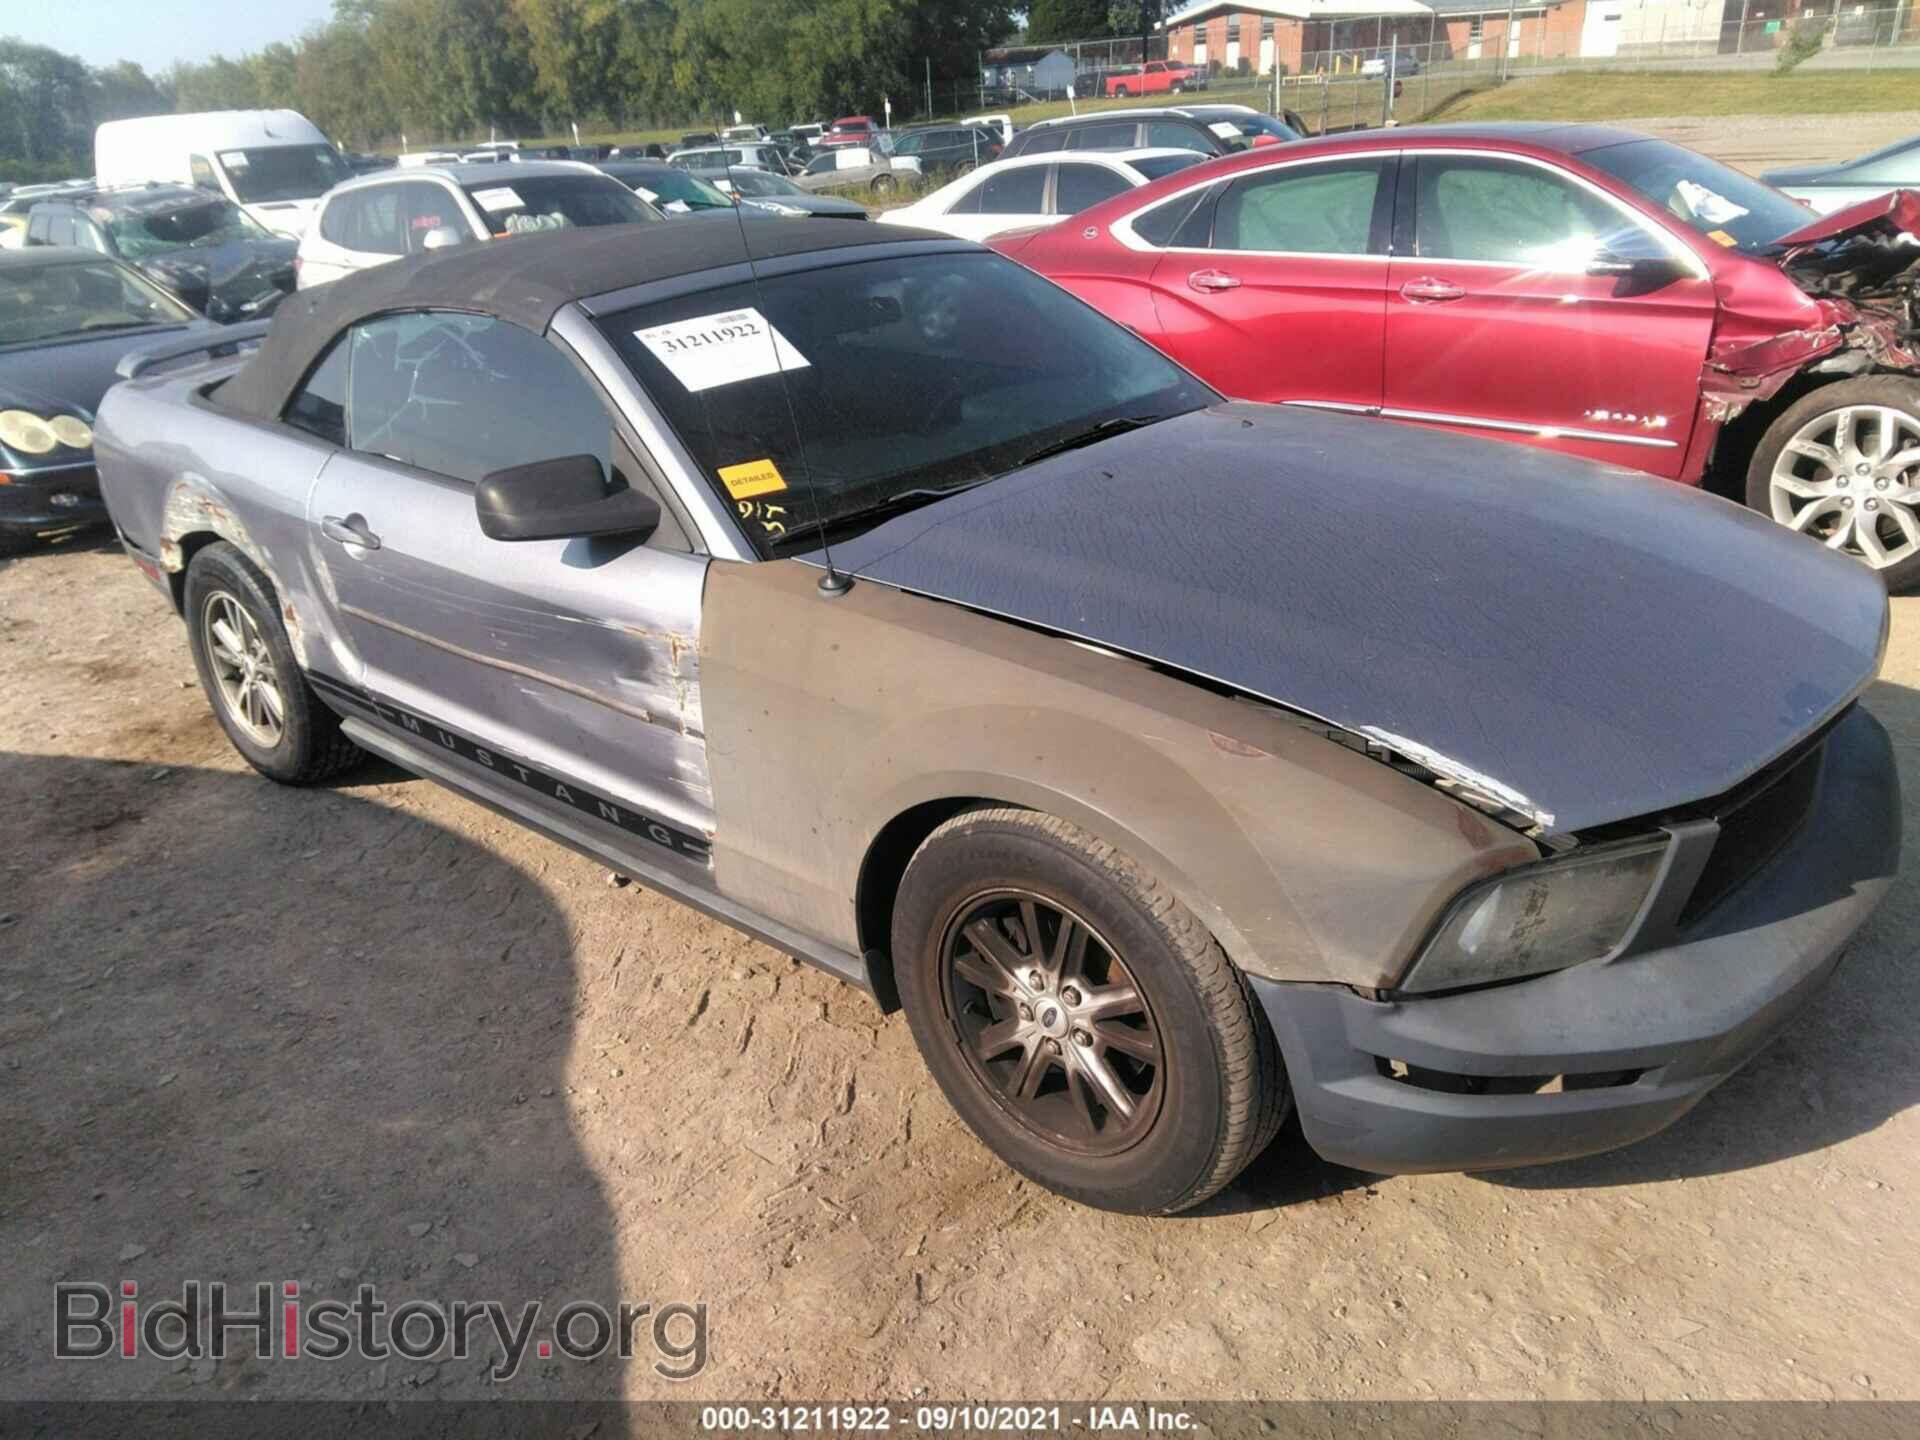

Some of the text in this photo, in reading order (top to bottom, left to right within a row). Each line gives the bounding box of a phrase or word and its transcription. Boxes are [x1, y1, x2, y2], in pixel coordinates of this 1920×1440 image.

[662, 323, 760, 353] 31211922
[730, 471, 775, 487] DETAILED
[400, 714, 672, 846] MUSTANG
